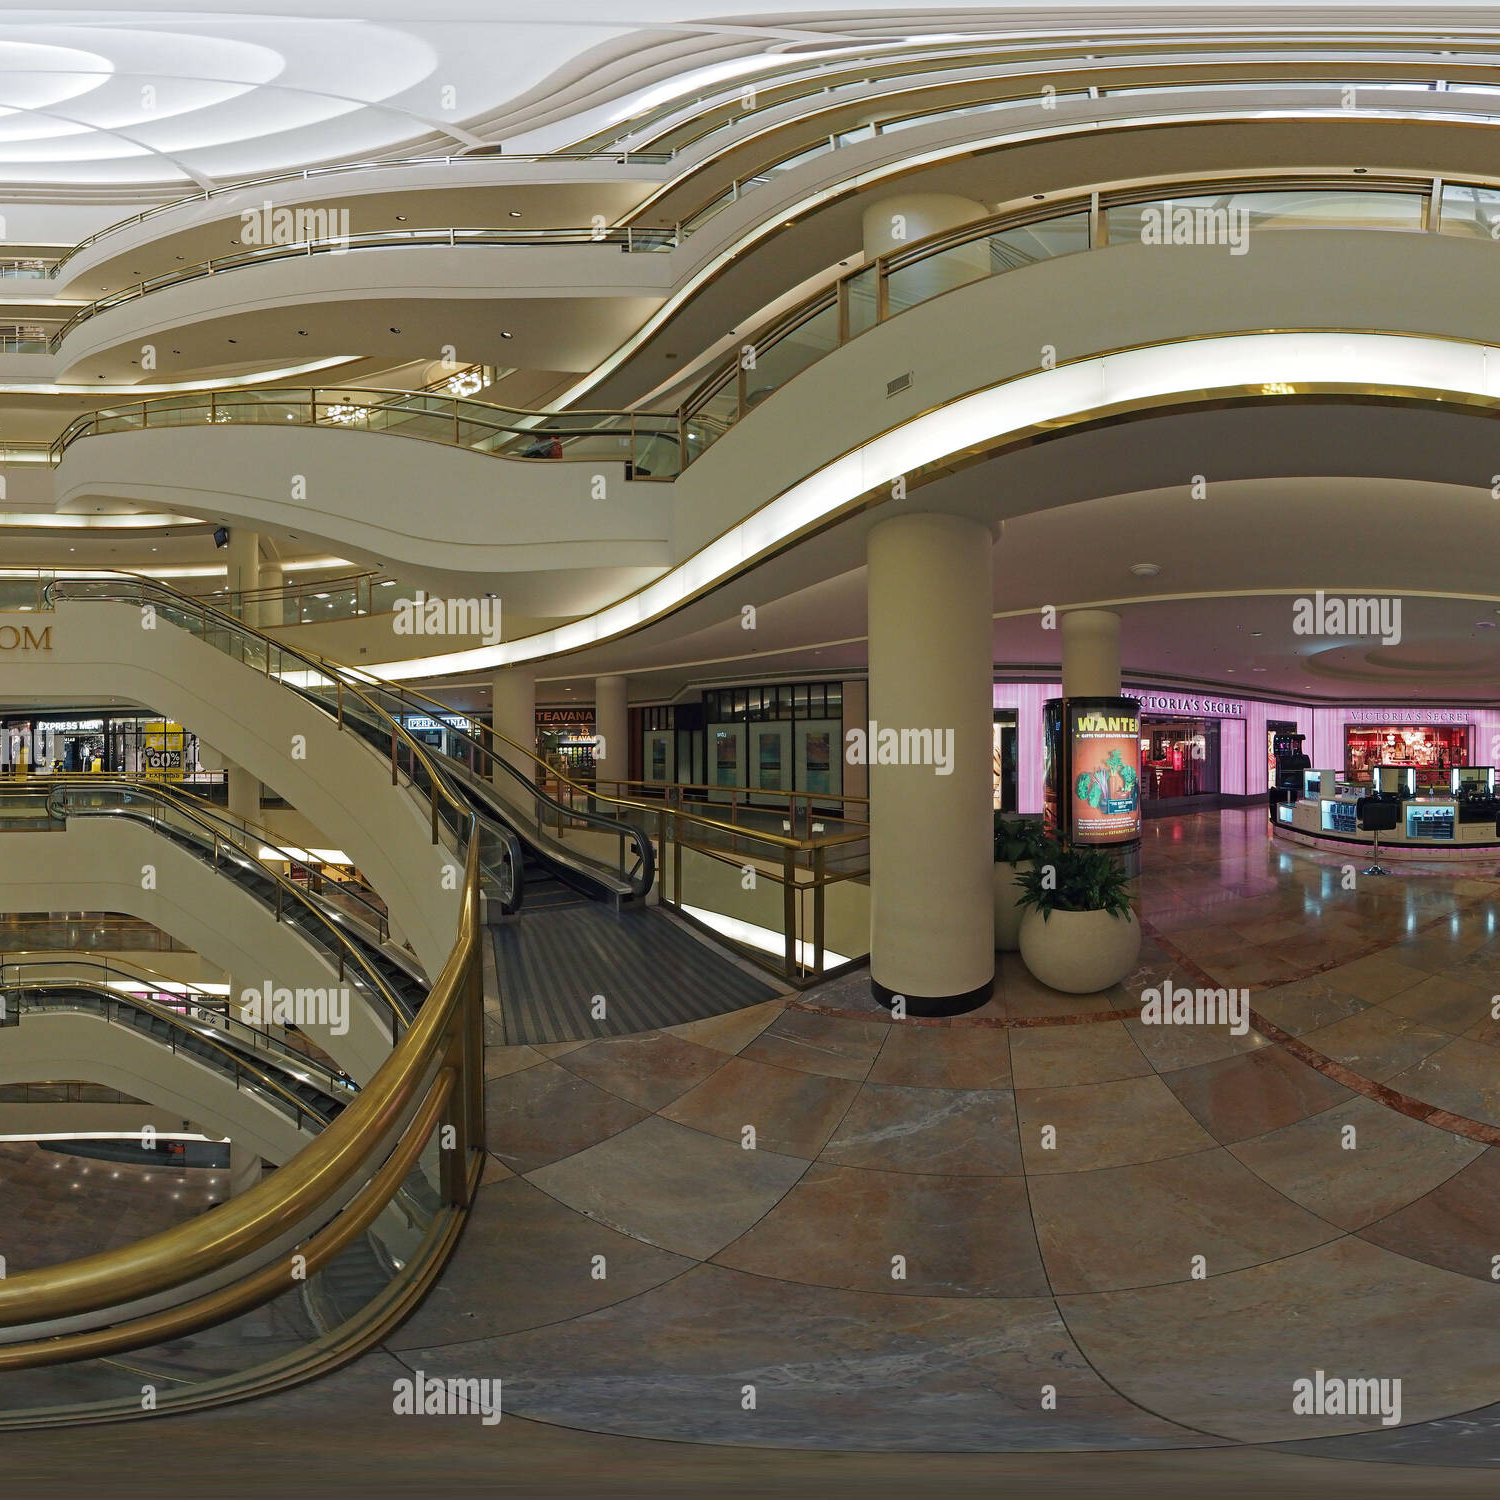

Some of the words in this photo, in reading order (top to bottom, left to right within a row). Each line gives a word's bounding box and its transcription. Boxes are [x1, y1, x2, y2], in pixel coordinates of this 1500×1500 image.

[1203, 698, 1244, 715] SECRET
[536, 711, 594, 721] TEAVANA
[1351, 711, 1421, 721] VICTORIA'S
[1426, 711, 1469, 722] SECRET
[38, 721, 78, 731] EXPRESS
[79, 719, 99, 730] MEN
[410, 719, 467, 728] PERFUNIA
[1077, 716, 1139, 733] WANTED
[149, 736, 181, 747] SALE
